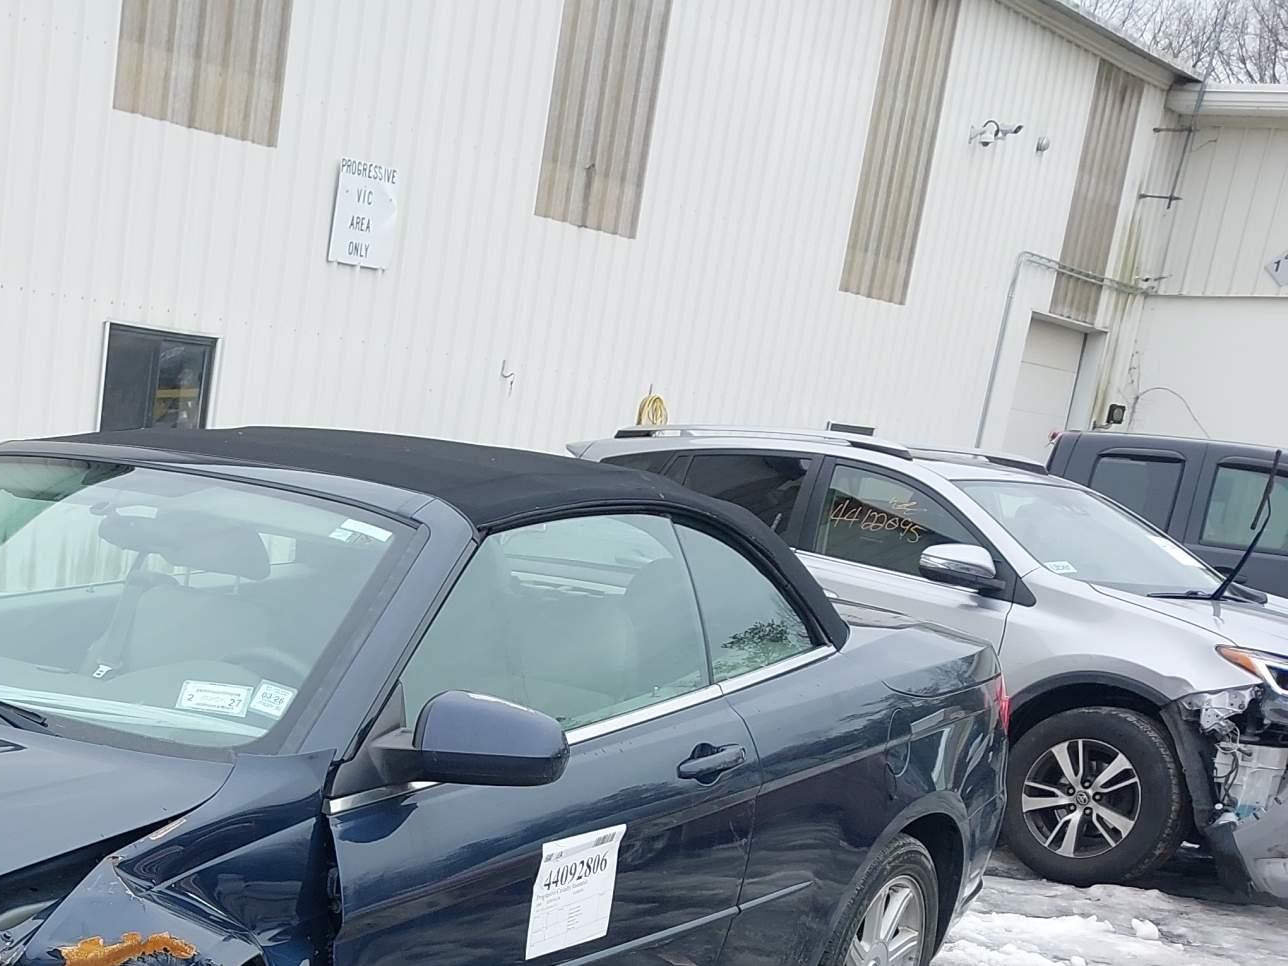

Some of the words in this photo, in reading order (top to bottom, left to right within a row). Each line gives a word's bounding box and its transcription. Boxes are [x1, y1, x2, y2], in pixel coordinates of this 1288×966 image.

[341, 158, 397, 184] PROGRESSIVE
[357, 188, 373, 205] VIC
[349, 215, 371, 232] AREA
[347, 241, 370, 258] ONLY
[186, 693, 194, 702] 2
[228, 698, 243, 707] 27
[543, 851, 609, 891] 44092806
